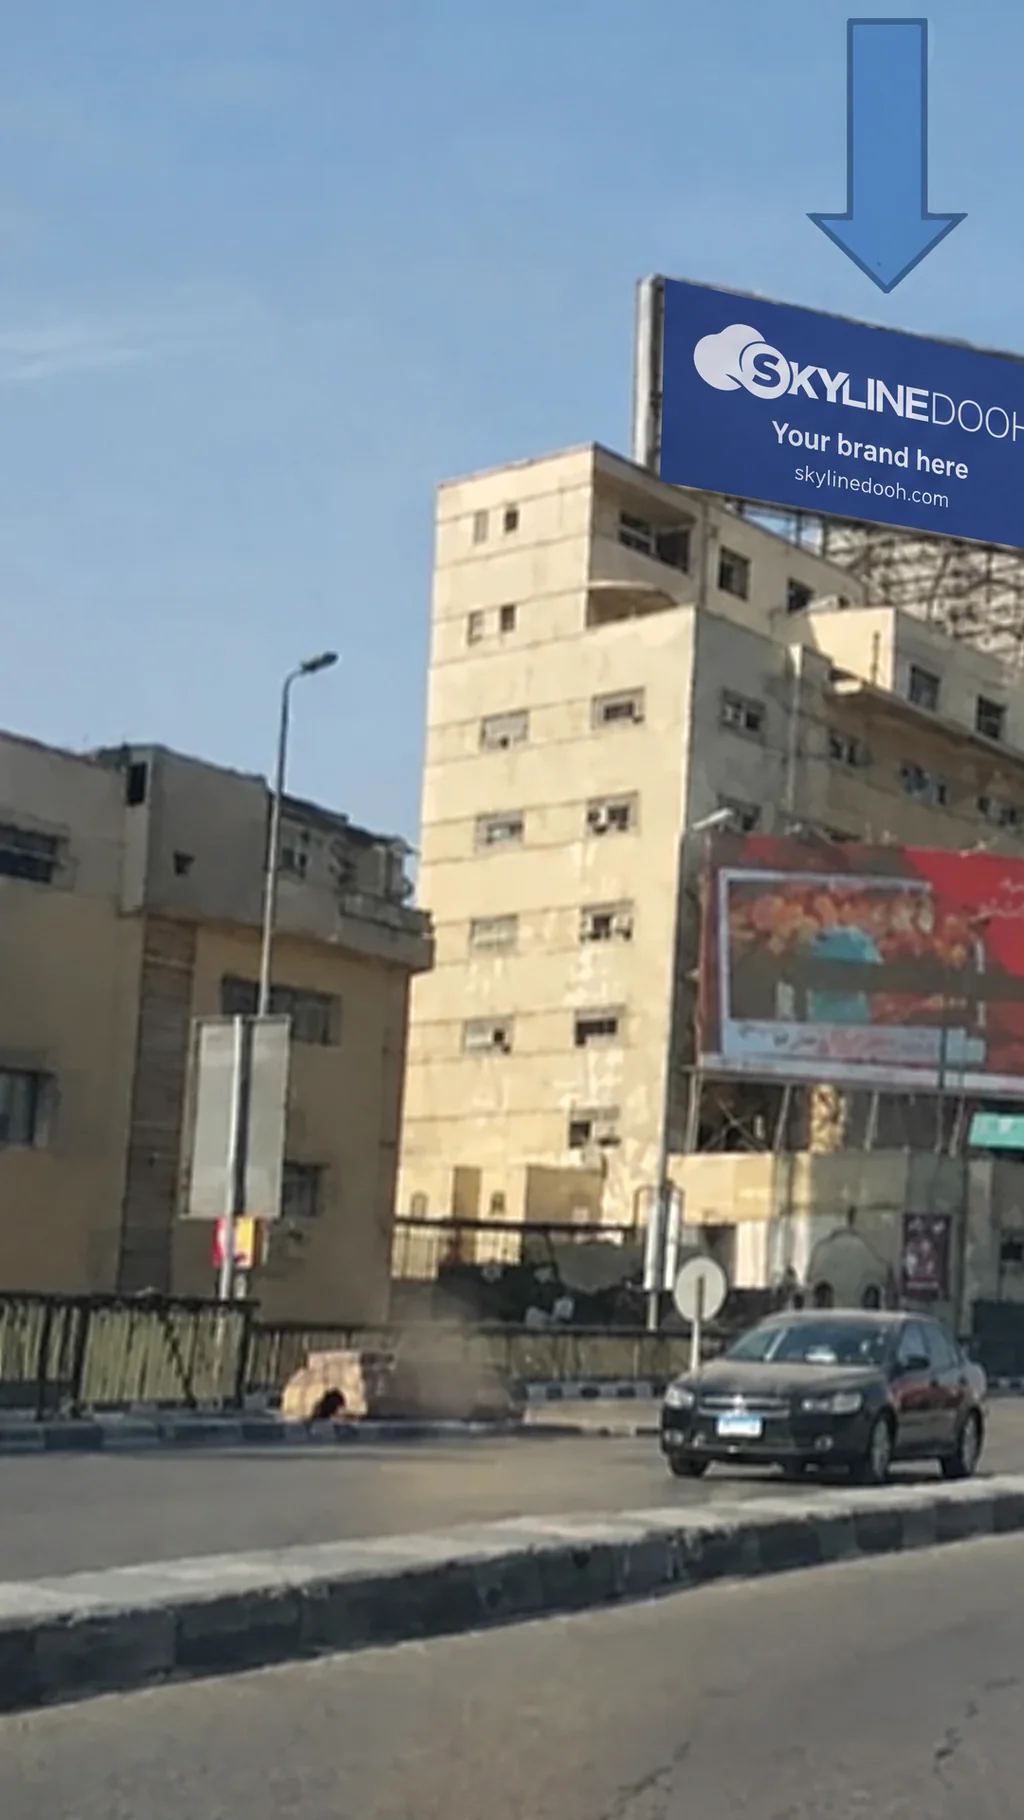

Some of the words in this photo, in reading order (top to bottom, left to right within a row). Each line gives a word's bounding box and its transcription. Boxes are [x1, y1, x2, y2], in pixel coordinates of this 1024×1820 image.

[771, 420, 831, 452] Your
[838, 432, 909, 469] brand
[916, 448, 969, 480] here
[794, 464, 949, 508] skylinedooh.com
